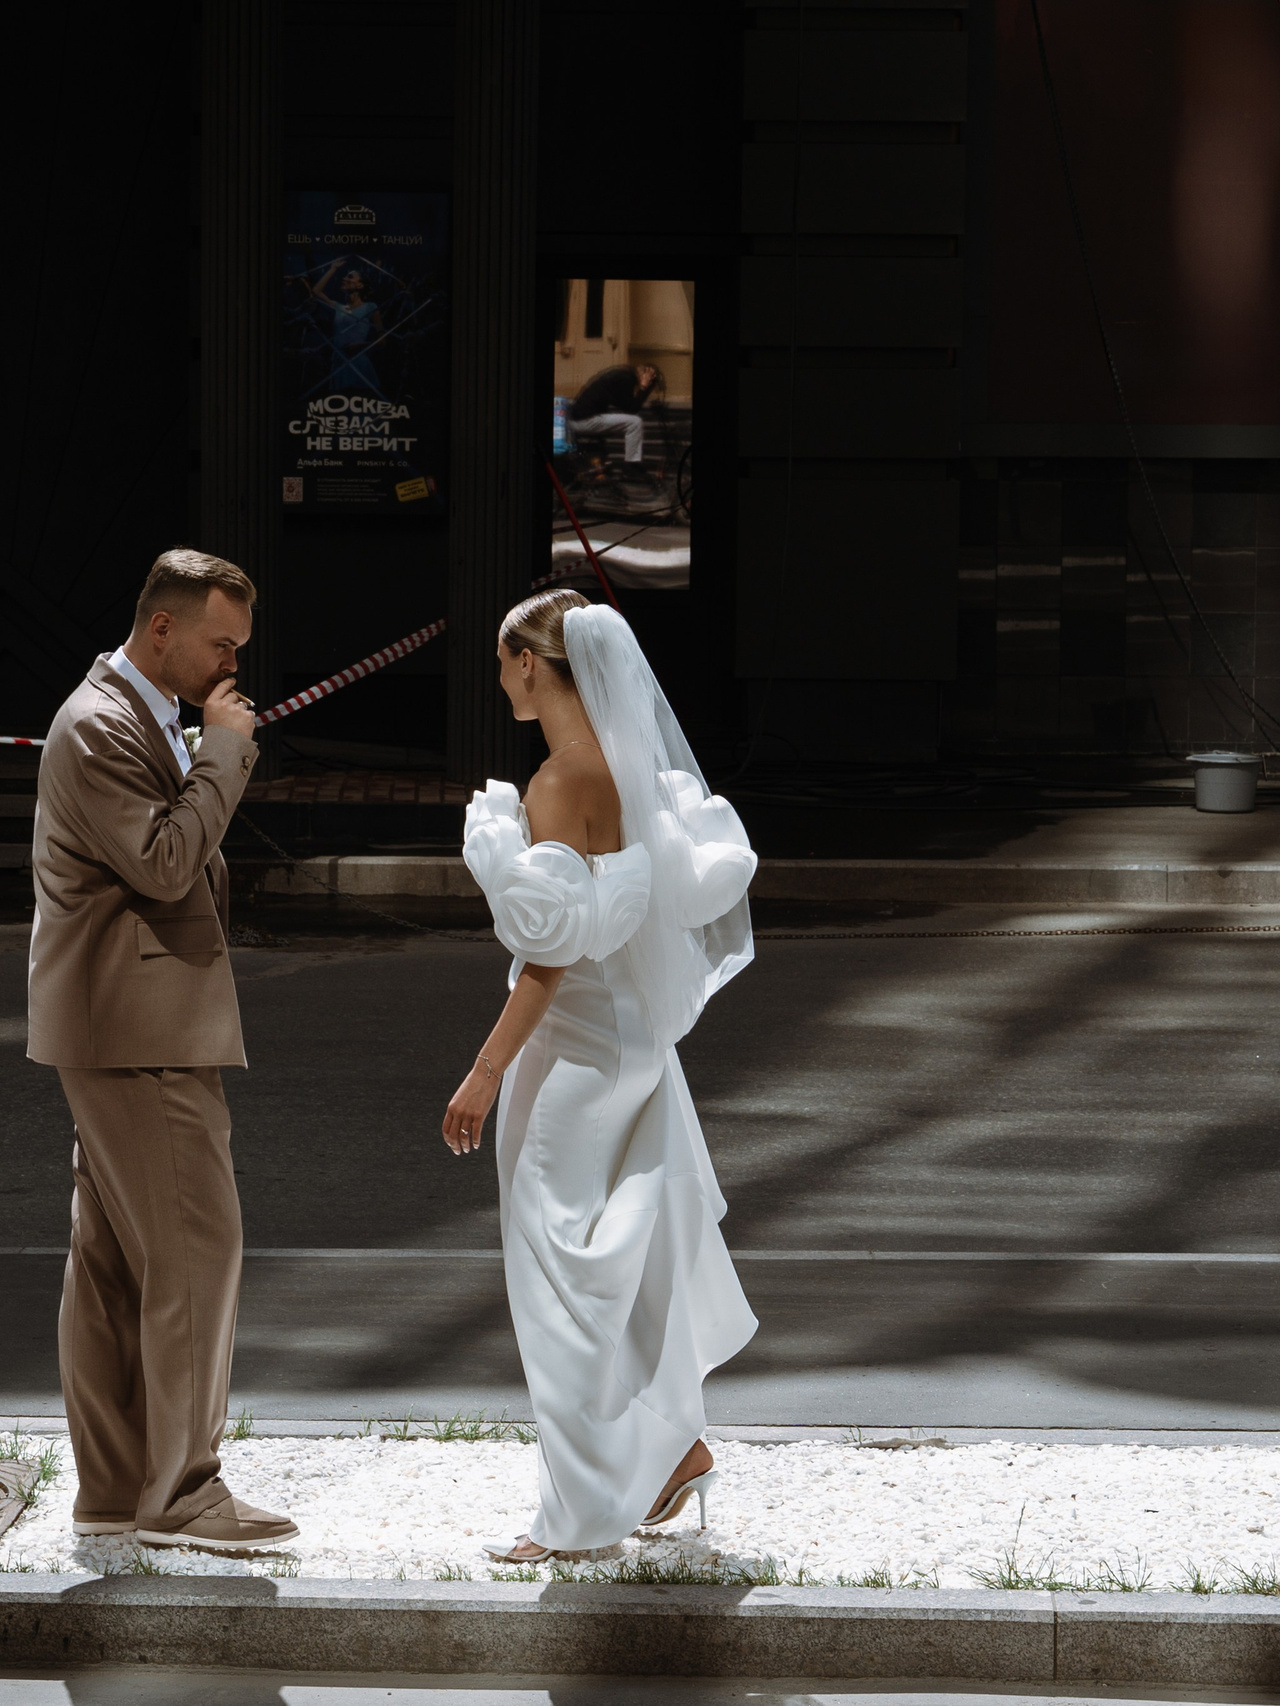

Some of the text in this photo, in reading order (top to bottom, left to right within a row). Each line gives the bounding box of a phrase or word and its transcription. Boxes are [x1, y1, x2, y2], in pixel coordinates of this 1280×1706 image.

[287, 233, 423, 246] ЕШЬ СМОТРИ ТАНЦУЙ
[306, 394, 411, 419] МОСКВА
[288, 415, 391, 435] СЛЕЗАМ
[306, 436, 418, 452] НЕ ВЕРИТ
[297, 458, 343, 467] Альфа Банк
